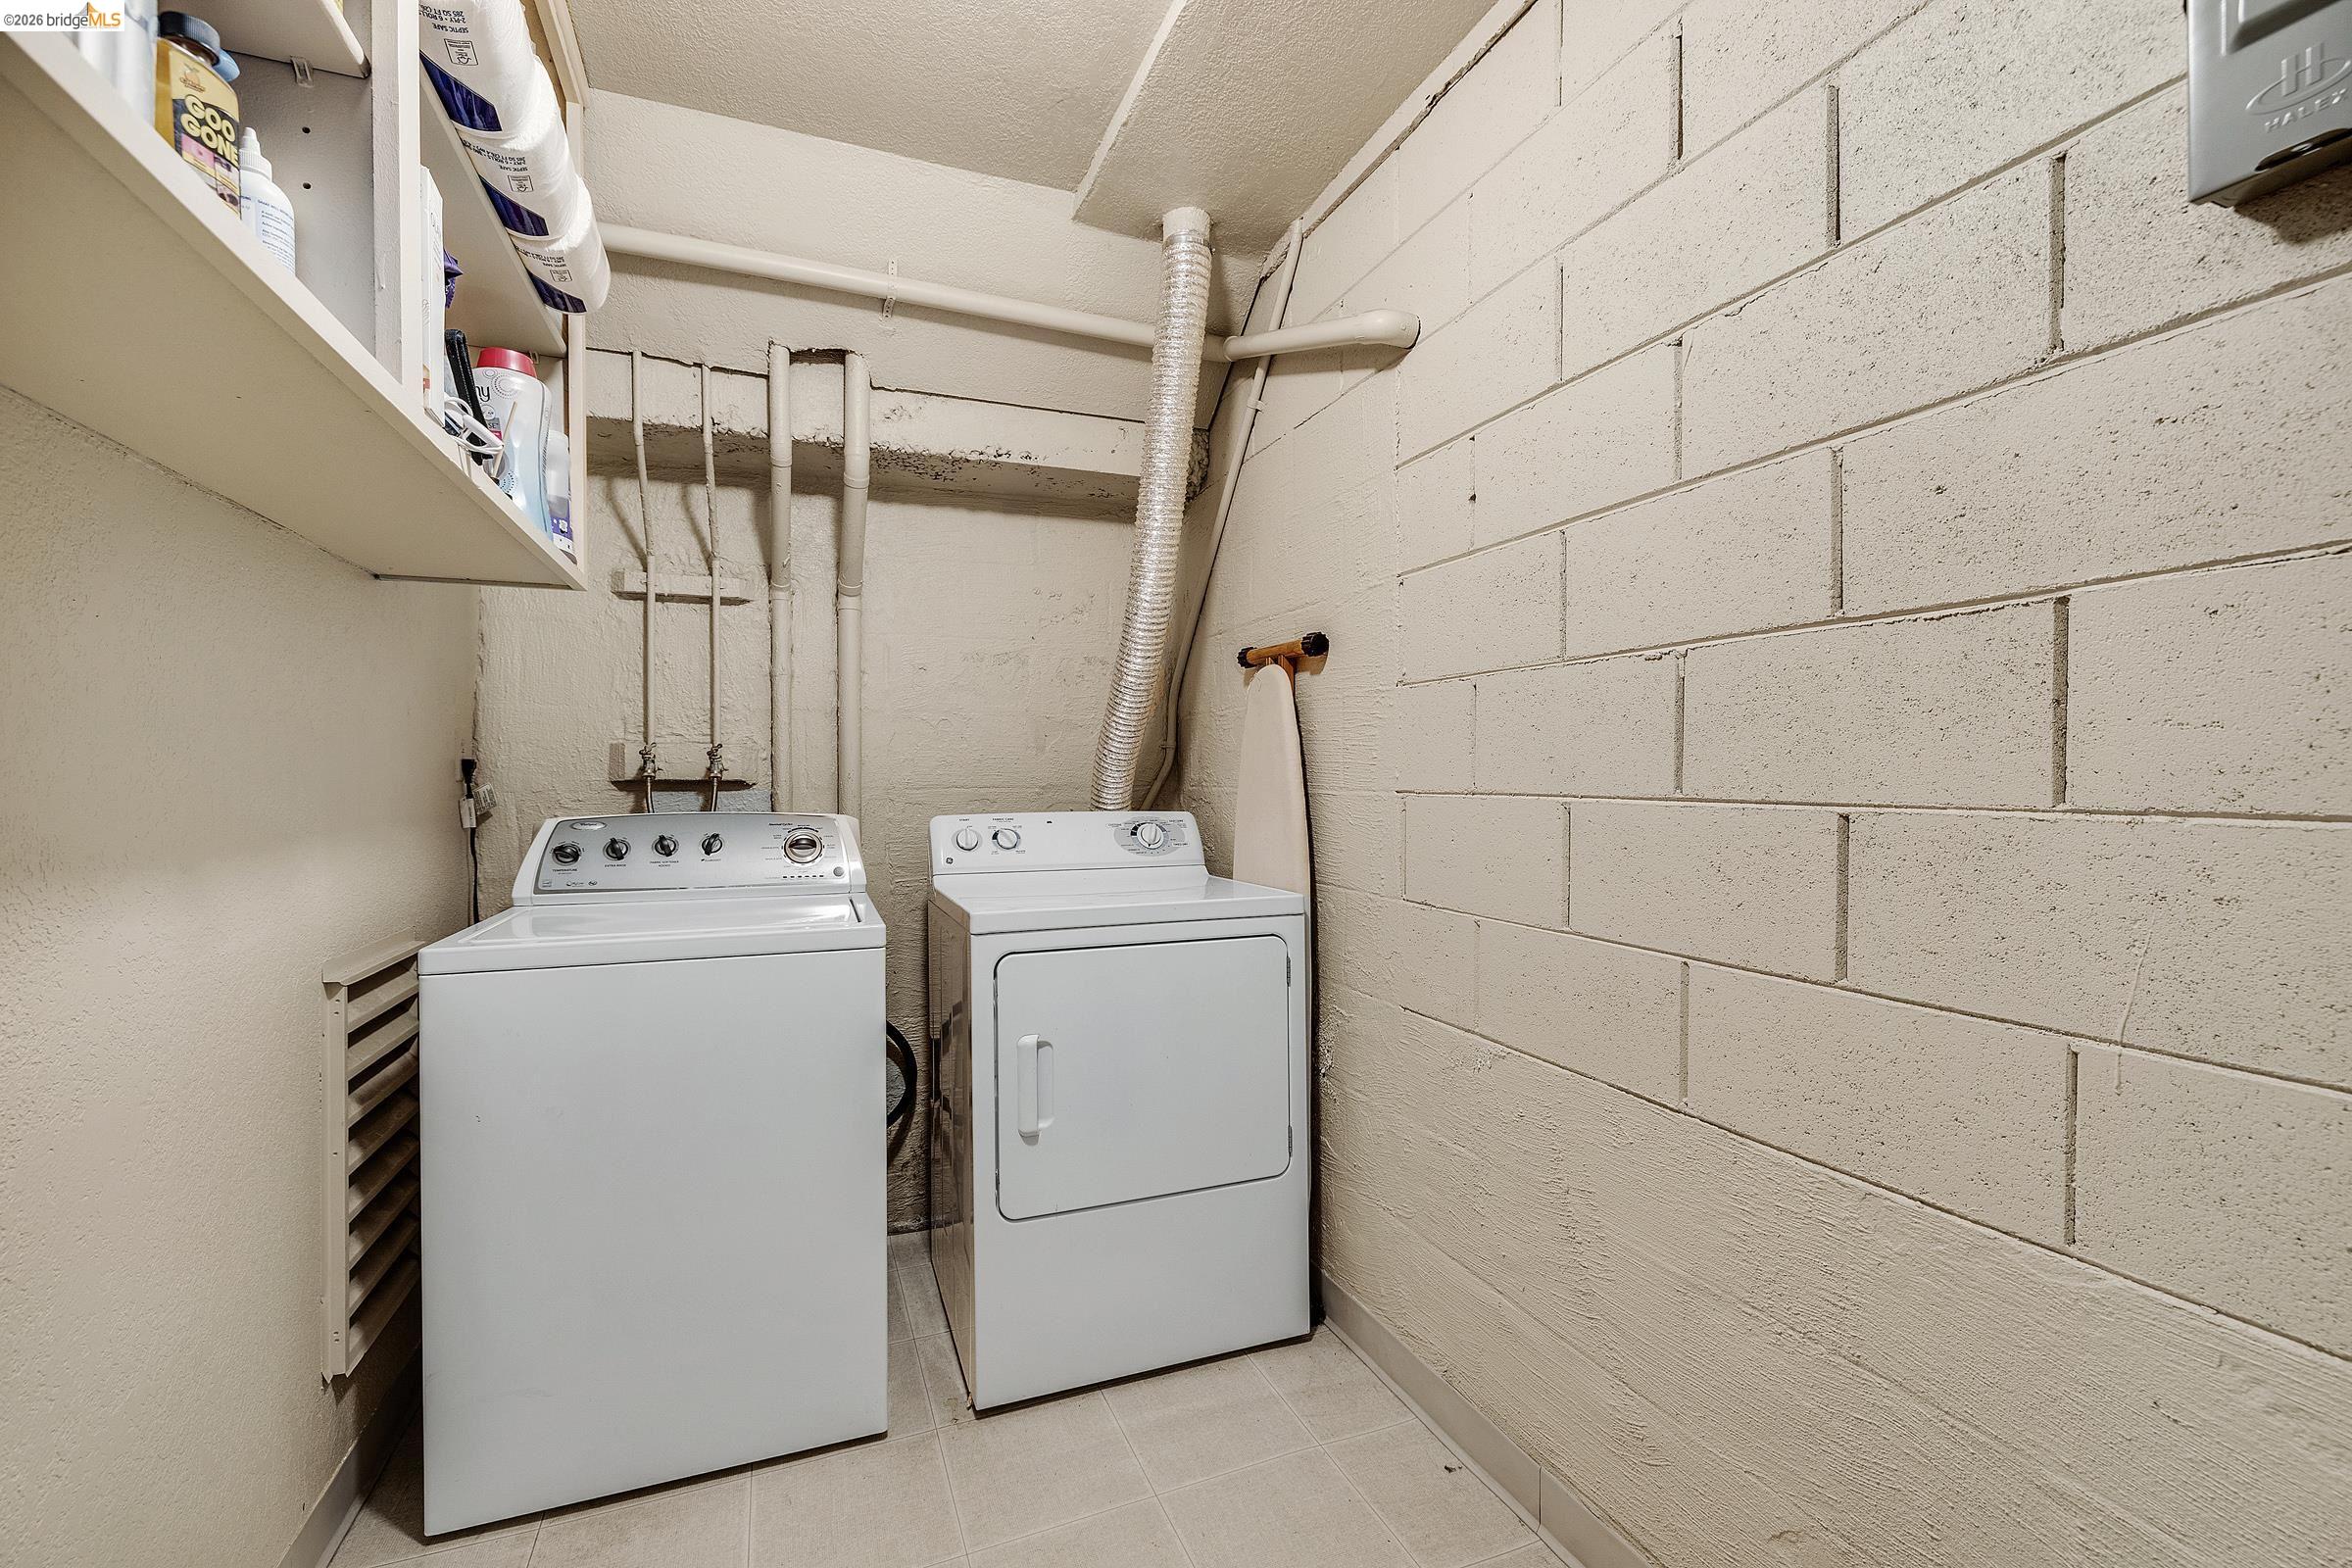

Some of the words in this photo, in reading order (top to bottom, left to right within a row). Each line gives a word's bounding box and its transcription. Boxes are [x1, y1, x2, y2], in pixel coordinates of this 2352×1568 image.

[432, 23, 448, 31] SAFE
[184, 94, 235, 142] GOO
[2264, 88, 2347, 133] HALEX
[180, 113, 239, 169] GONE
